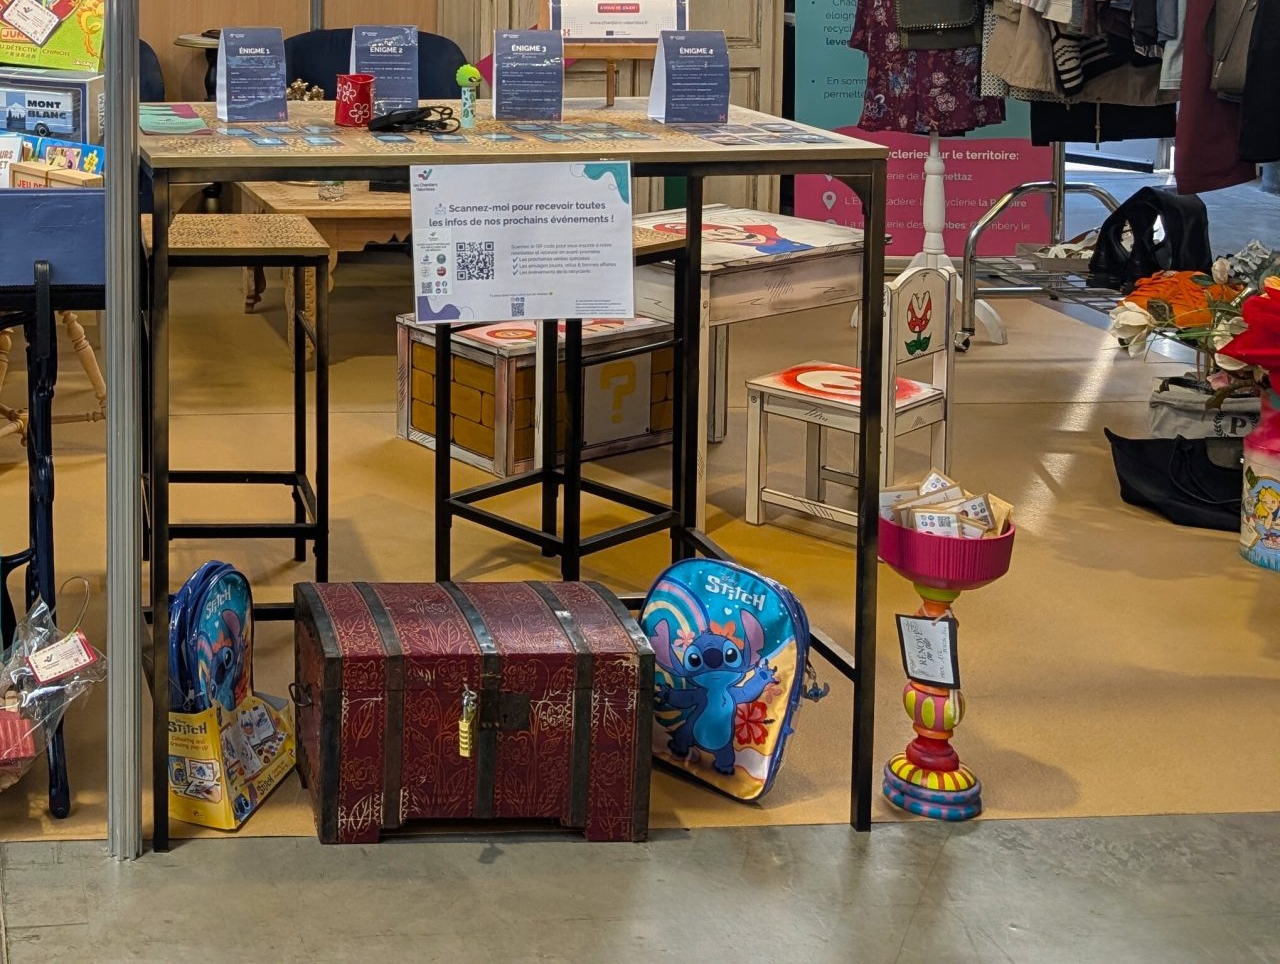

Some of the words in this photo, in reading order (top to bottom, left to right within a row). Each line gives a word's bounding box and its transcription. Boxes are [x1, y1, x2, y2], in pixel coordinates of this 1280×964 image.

[239, 46, 266, 54] ÉNIGME
[511, 44, 541, 52] ÉNIGME
[679, 46, 708, 55] ÉNIGME
[27, 99, 61, 109] MONT
[27, 110, 67, 120] BLANC
[953, 150, 964, 159] le
[966, 150, 1020, 160] territoire:
[448, 202, 510, 213] Scannez-moi
[511, 203, 534, 213] pour
[535, 201, 574, 211] recevoir
[575, 201, 606, 210] toutes
[428, 218, 443, 227] les
[444, 217, 468, 226] infos
[469, 217, 482, 226] de
[484, 218, 501, 226] nos
[502, 215, 549, 227] prochains
[550, 214, 609, 224] événements
[1229, 417, 1247, 435] P
